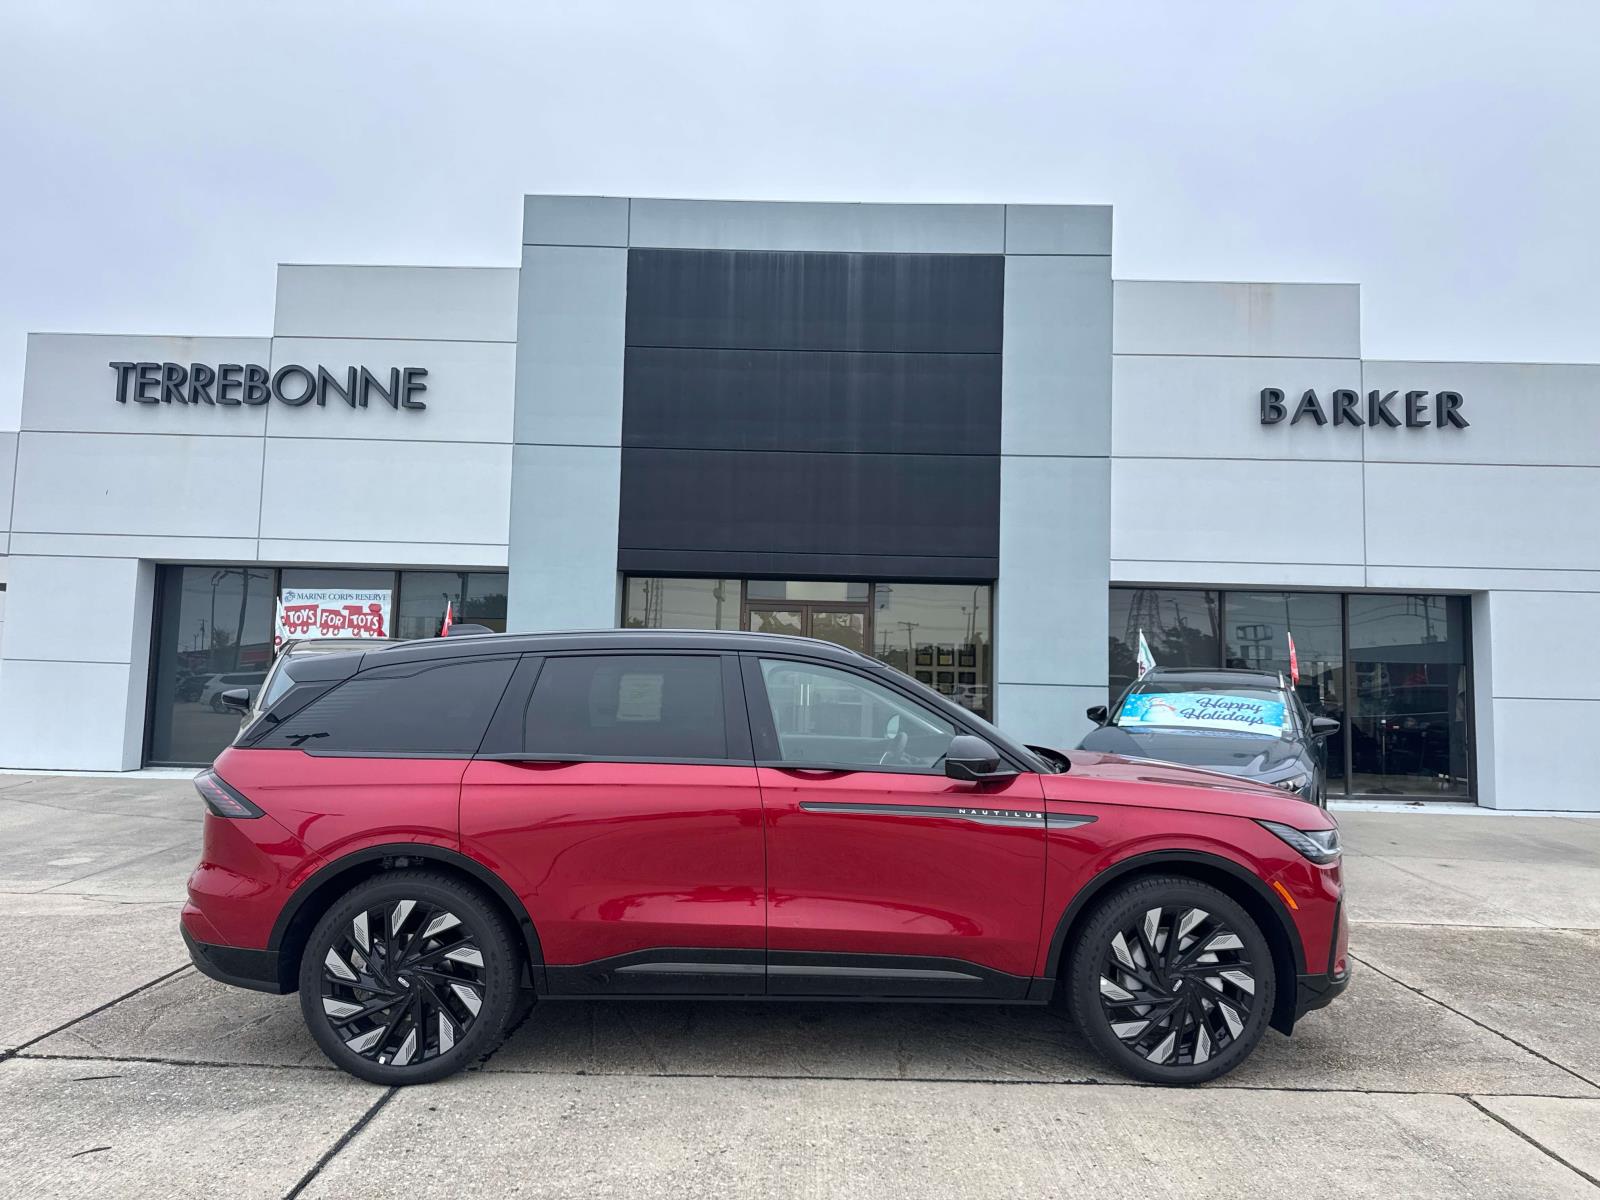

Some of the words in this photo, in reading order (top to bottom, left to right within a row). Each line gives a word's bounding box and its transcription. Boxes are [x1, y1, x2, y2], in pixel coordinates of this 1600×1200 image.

[109, 361, 428, 409] TERREBONNE
[1260, 387, 1470, 429] BARKER
[296, 592, 327, 600] MARINE
[328, 592, 354, 600] CORPS
[355, 593, 387, 601] RESERVE
[287, 608, 315, 624] TOYS
[321, 612, 343, 626] FOR
[350, 615, 379, 630] TOTS
[1196, 697, 1263, 714] Happy
[1180, 707, 1264, 726] Holidays
[958, 808, 1043, 819] NAUTILUS
